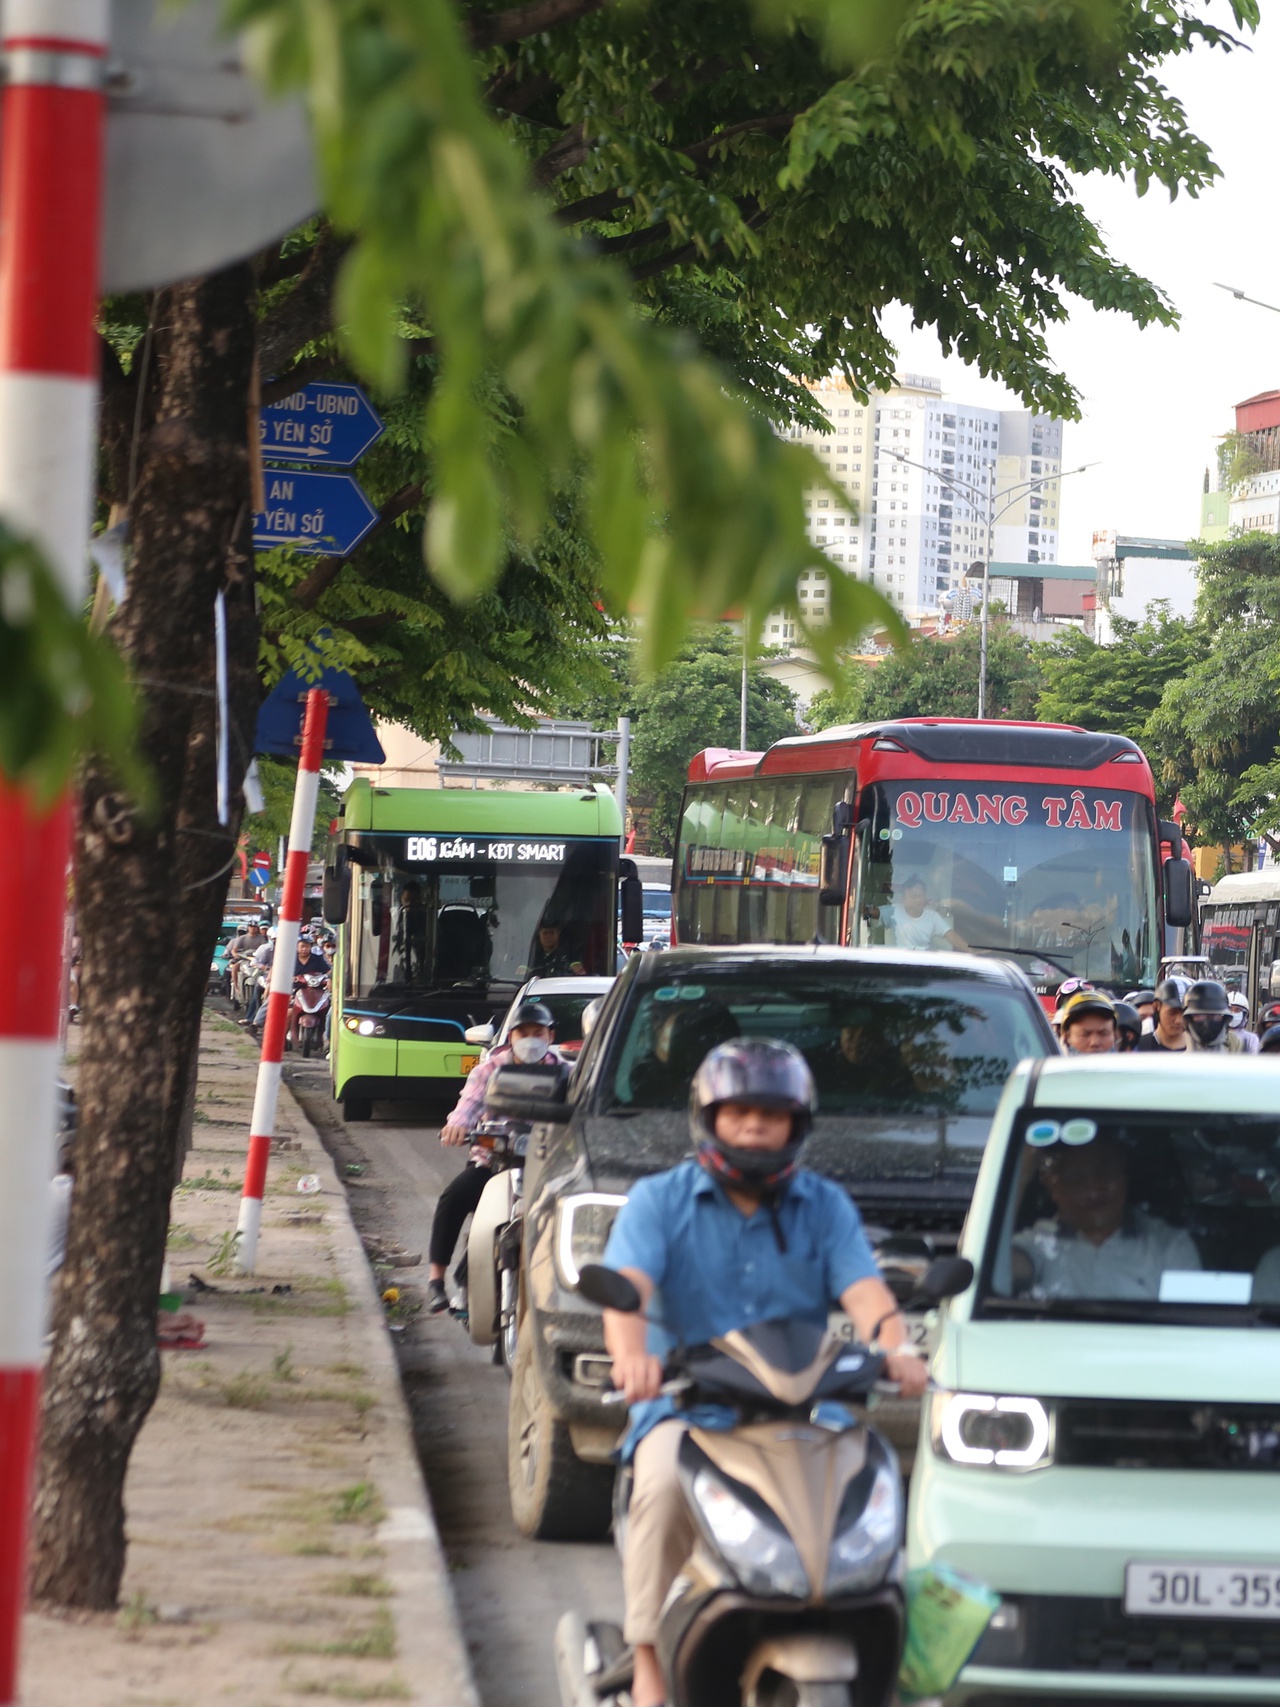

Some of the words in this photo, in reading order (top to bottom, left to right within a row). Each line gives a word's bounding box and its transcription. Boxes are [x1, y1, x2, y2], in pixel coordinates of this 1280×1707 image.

[273, 419, 305, 443] YÊN
[309, 419, 334, 444] SỞ
[270, 480, 294, 501] AN
[264, 508, 296, 532] YÊN
[301, 508, 325, 534] SỞ
[896, 790, 1029, 828] QUANG
[1041, 789, 1123, 831] TÂM
[407, 837, 438, 861] E06
[517, 843, 567, 861] SMART
